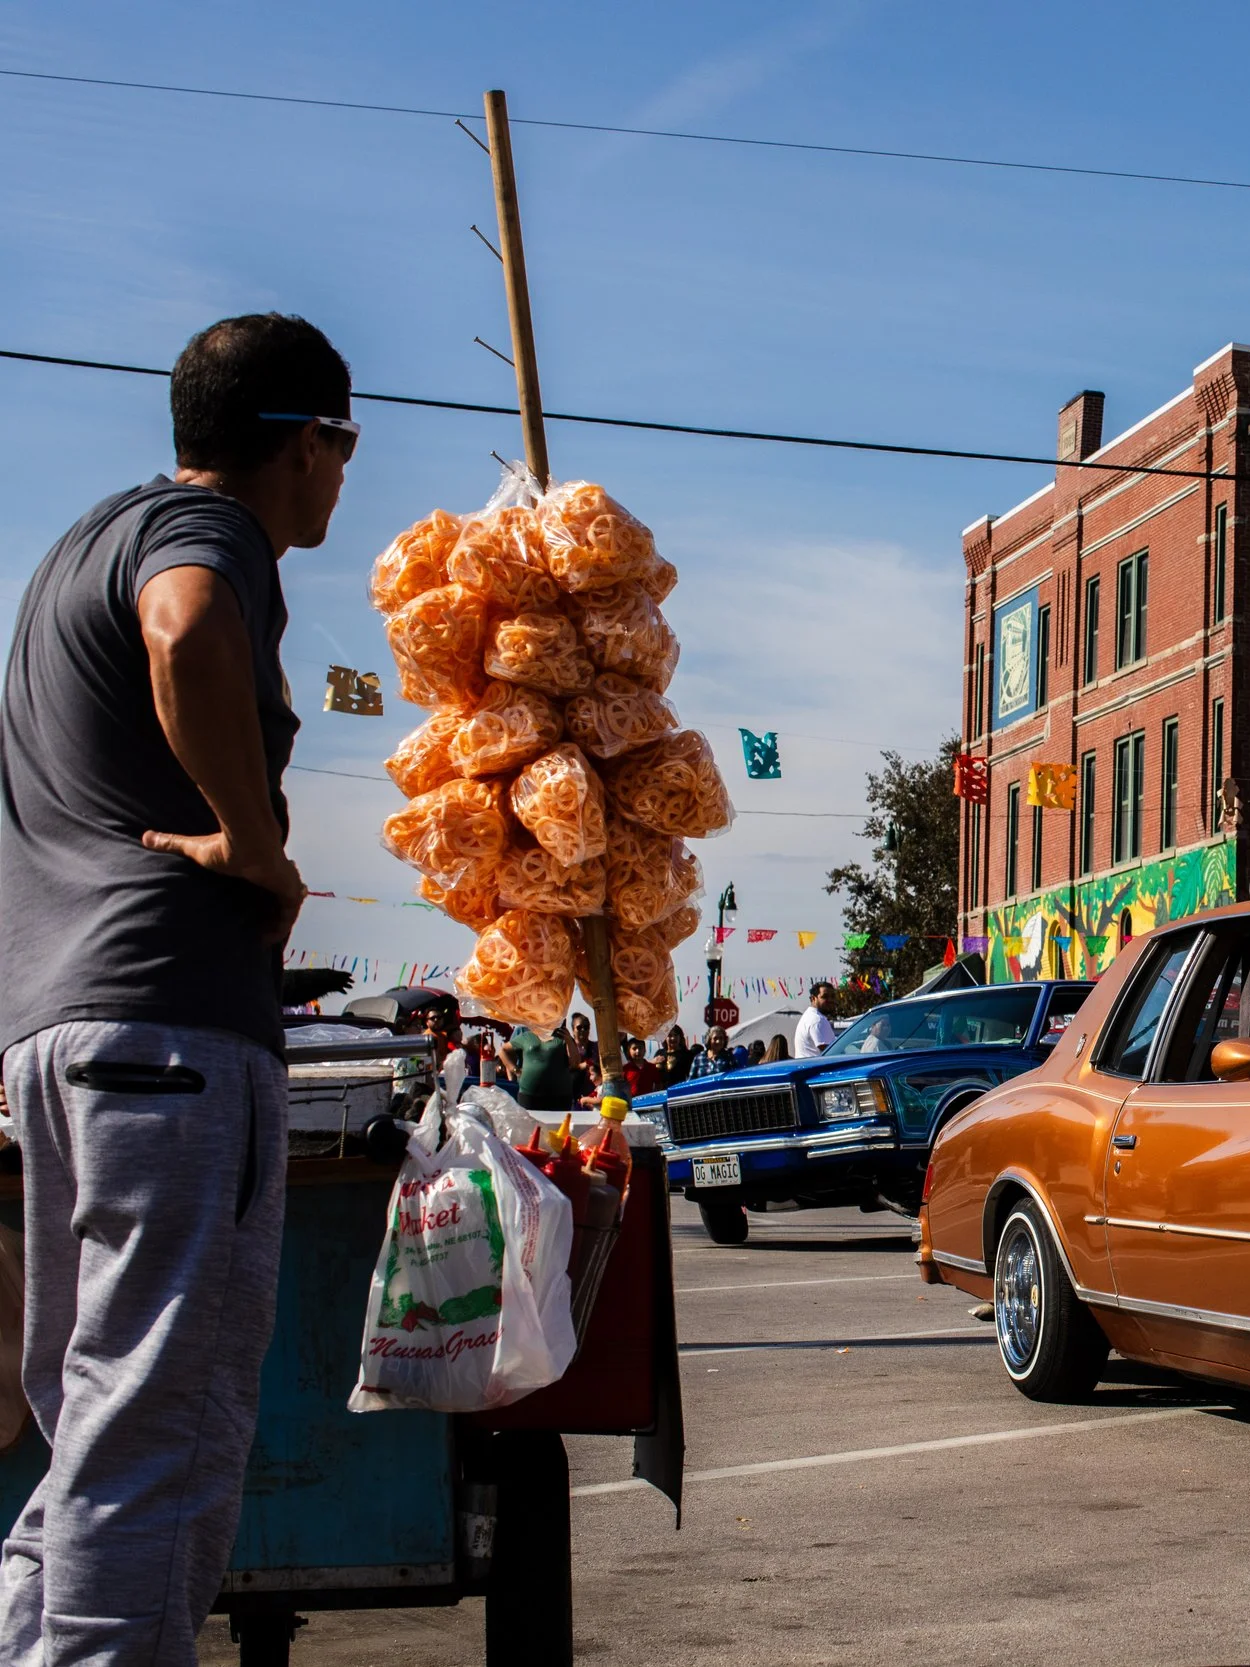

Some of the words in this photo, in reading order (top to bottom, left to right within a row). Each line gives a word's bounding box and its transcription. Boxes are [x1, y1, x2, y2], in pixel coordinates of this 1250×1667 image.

[707, 1008, 738, 1023] TOP
[695, 1166, 706, 1181] OG
[710, 1163, 739, 1180] MAGIC
